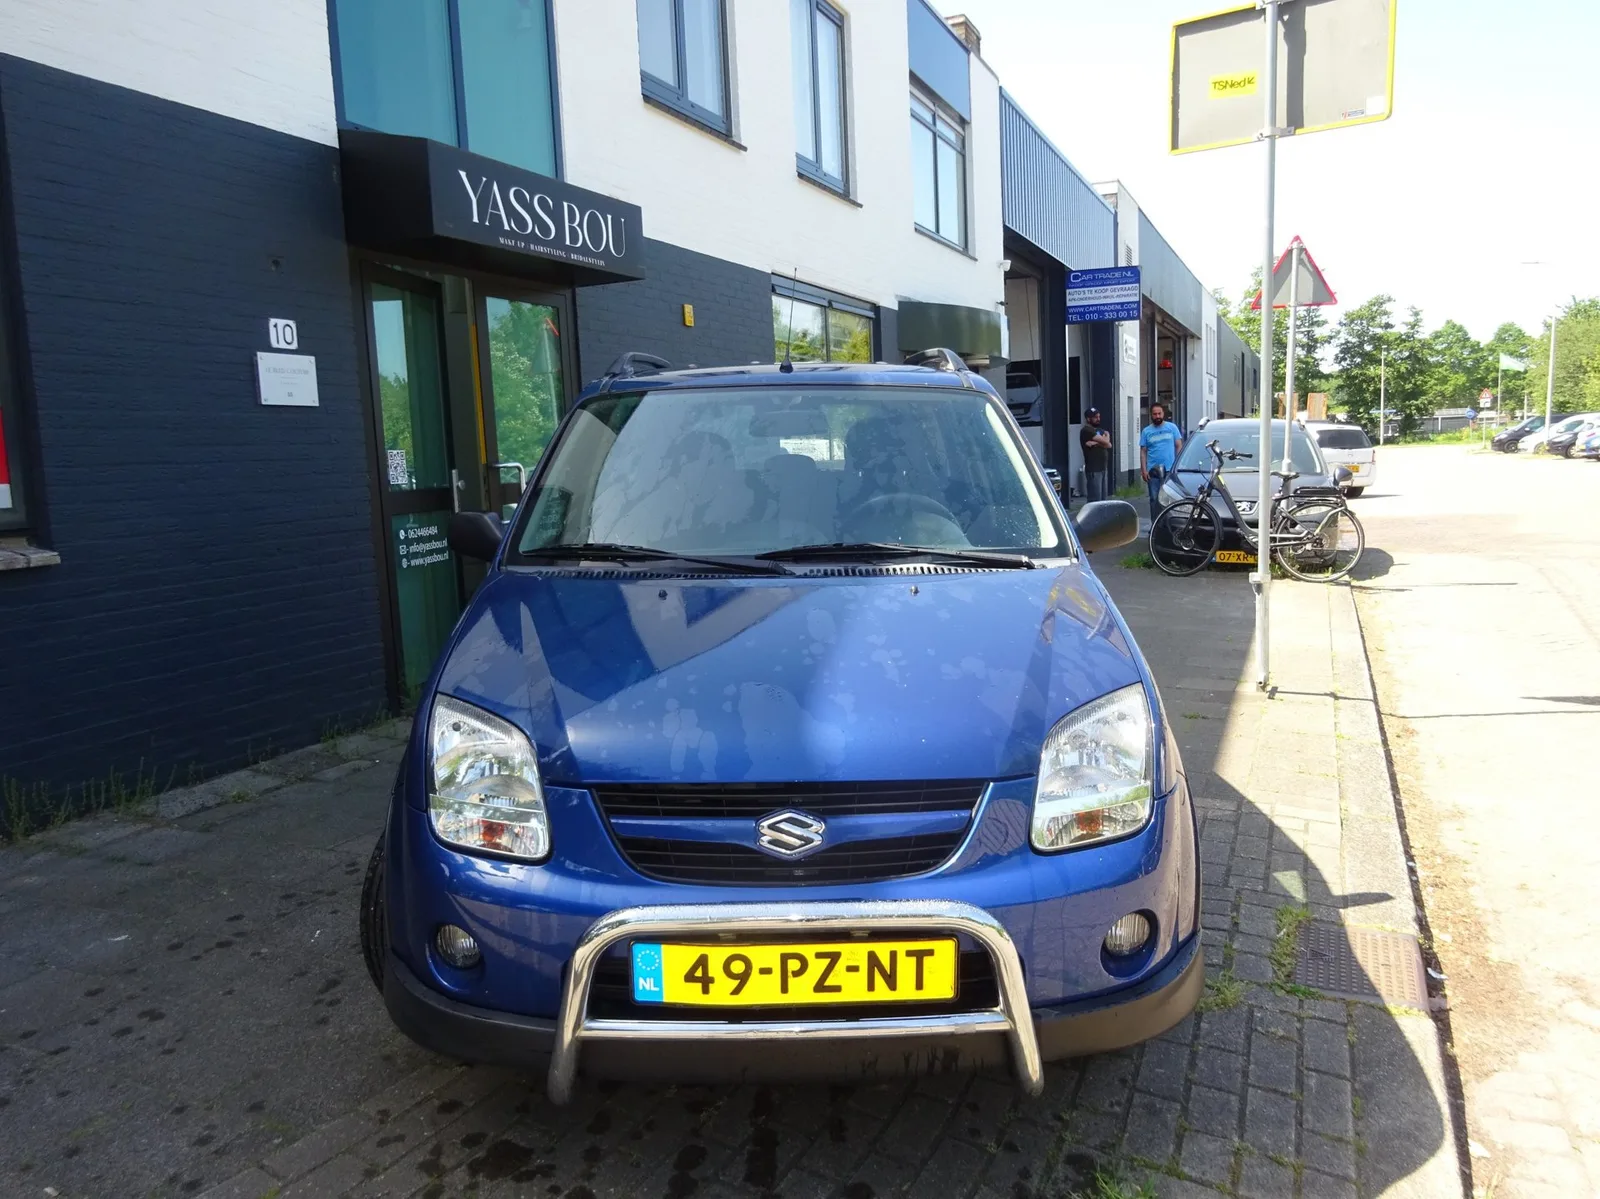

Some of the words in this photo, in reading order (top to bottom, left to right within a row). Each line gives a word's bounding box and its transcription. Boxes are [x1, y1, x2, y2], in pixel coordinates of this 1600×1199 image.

[458, 169, 556, 240] YASS
[563, 201, 626, 258] BOU
[499, 236, 515, 247] MAKE
[517, 240, 526, 249] UP
[530, 243, 567, 258] HAIRSTYLING
[1070, 272, 1093, 283] CAR
[1094, 271, 1121, 280] TRADE
[1110, 285, 1138, 293] GEVRAAGD
[1068, 303, 1138, 313] WWW.CARTRADENL.COM
[273, 322, 295, 345] 10
[683, 949, 936, 996] 49-PZ-NT
[639, 977, 660, 991] NL
